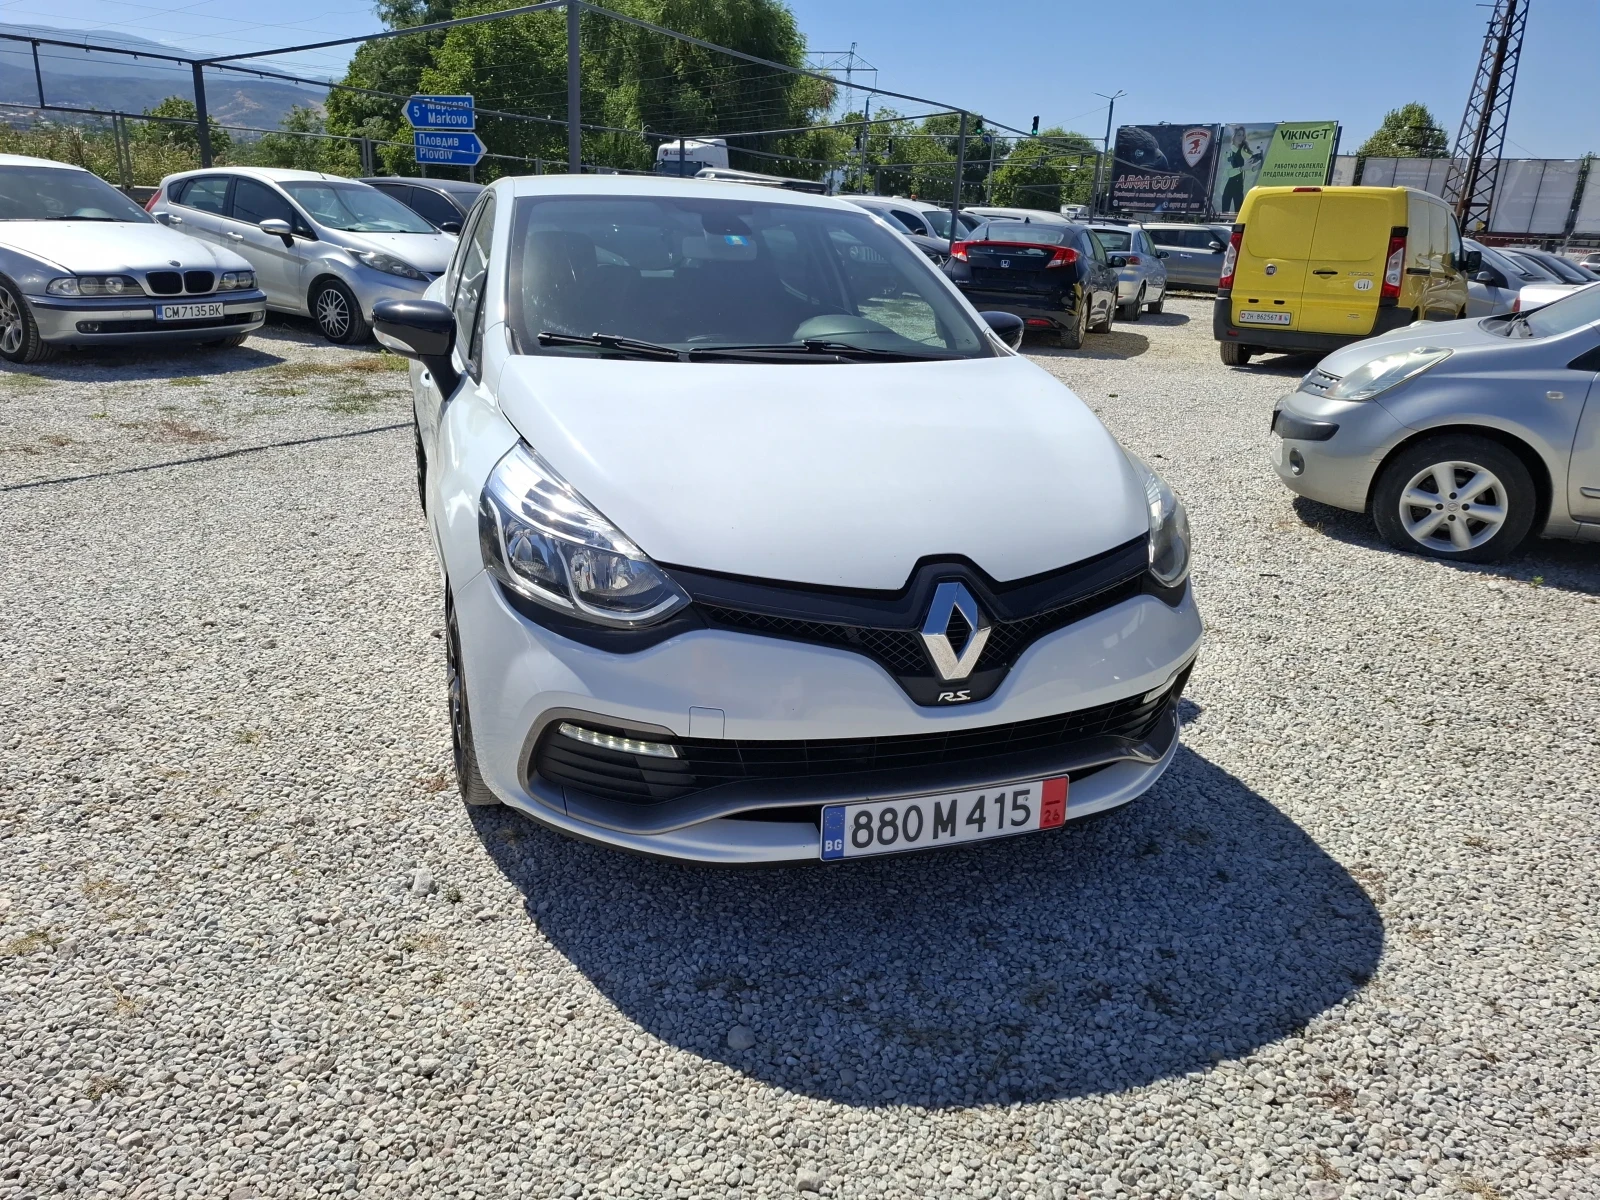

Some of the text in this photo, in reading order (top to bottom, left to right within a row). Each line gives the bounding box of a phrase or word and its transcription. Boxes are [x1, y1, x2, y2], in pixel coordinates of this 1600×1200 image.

[413, 105, 420, 117] 5
[427, 112, 468, 124] Markovo
[418, 134, 459, 147] Пловдив
[1280, 128, 1331, 141] VIKING-T
[164, 307, 180, 318] CM
[181, 306, 206, 317] 7135
[208, 304, 221, 315] BK
[824, 788, 1060, 852] BG 880 M 415 26
